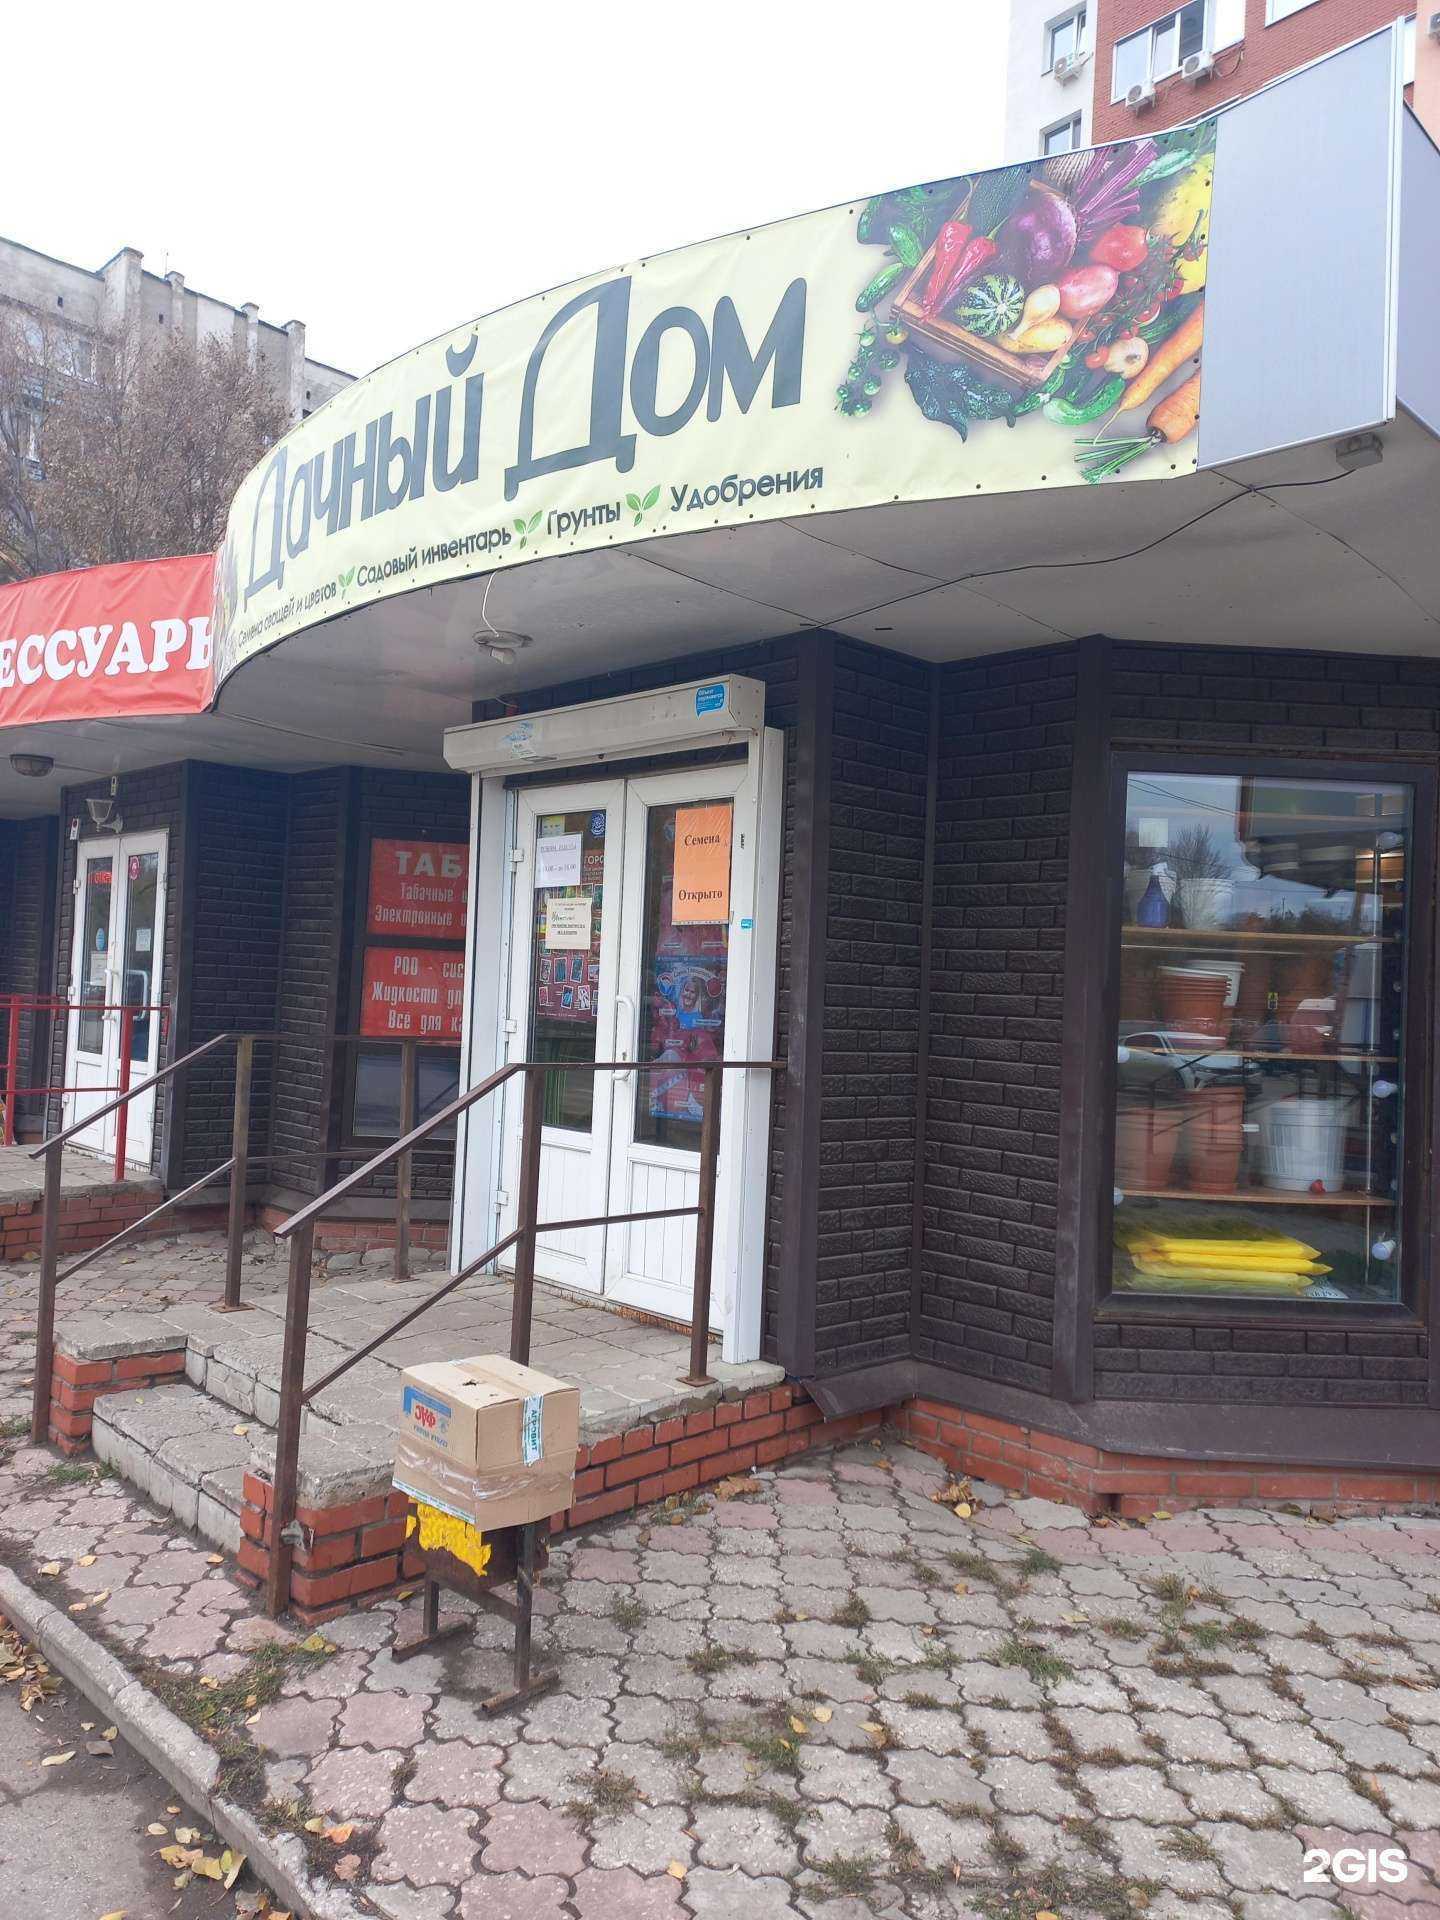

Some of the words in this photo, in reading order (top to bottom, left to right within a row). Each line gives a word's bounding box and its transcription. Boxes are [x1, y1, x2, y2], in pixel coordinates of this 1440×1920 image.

[244, 333, 485, 613] Дачный
[504, 275, 808, 501] Дом
[238, 620, 263, 647] Семена
[357, 546, 418, 587] Садовый
[421, 526, 512, 566] инвентарь
[547, 502, 621, 538] Грунты
[670, 467, 824, 512] Удобрения
[684, 834, 721, 847] Семена
[395, 850, 468, 879] ТАБ
[400, 882, 454, 903] Табачные
[678, 888, 723, 903] Открыто
[374, 904, 453, 927] Электронные
[371, 980, 438, 1006] Жидкости
[447, 989, 464, 1009] дл
[420, 1014, 442, 1035] для
